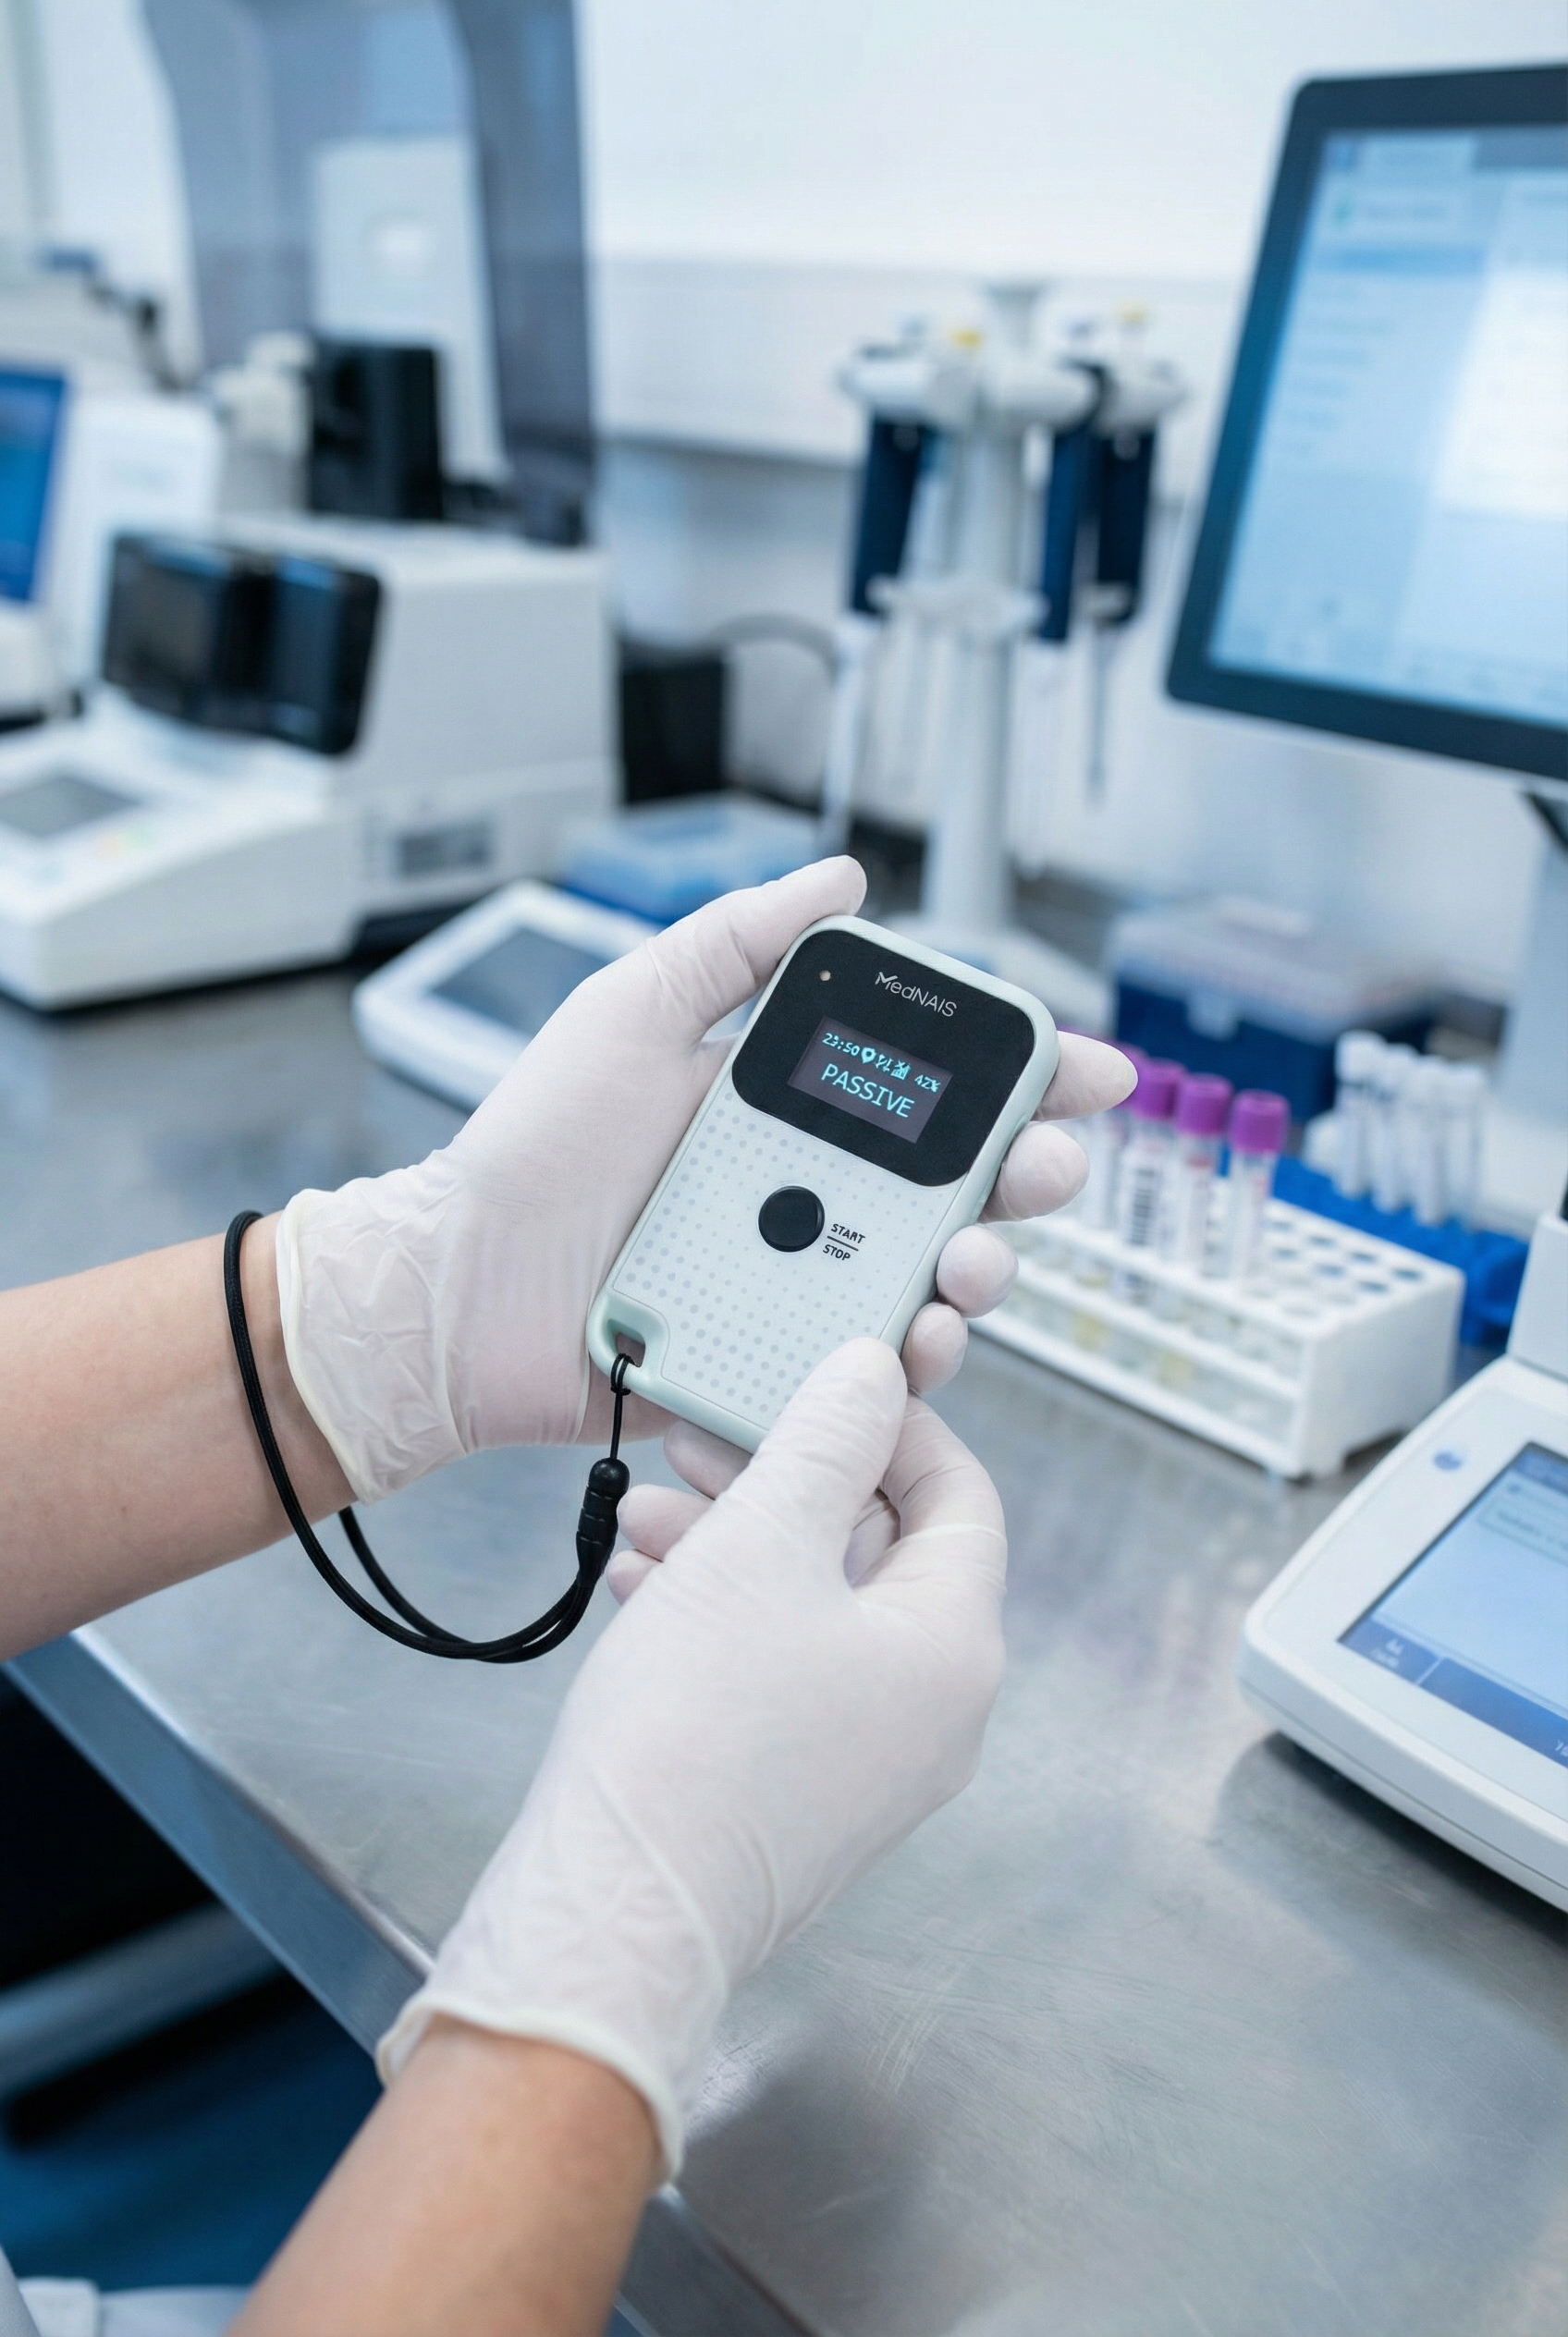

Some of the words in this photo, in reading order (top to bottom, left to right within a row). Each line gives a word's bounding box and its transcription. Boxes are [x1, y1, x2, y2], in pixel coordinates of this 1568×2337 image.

[875, 972, 957, 1017] MedNAIS
[821, 1063, 915, 1118] PASSIVE
[831, 1223, 865, 1244] START
[822, 1244, 851, 1262] STOP
